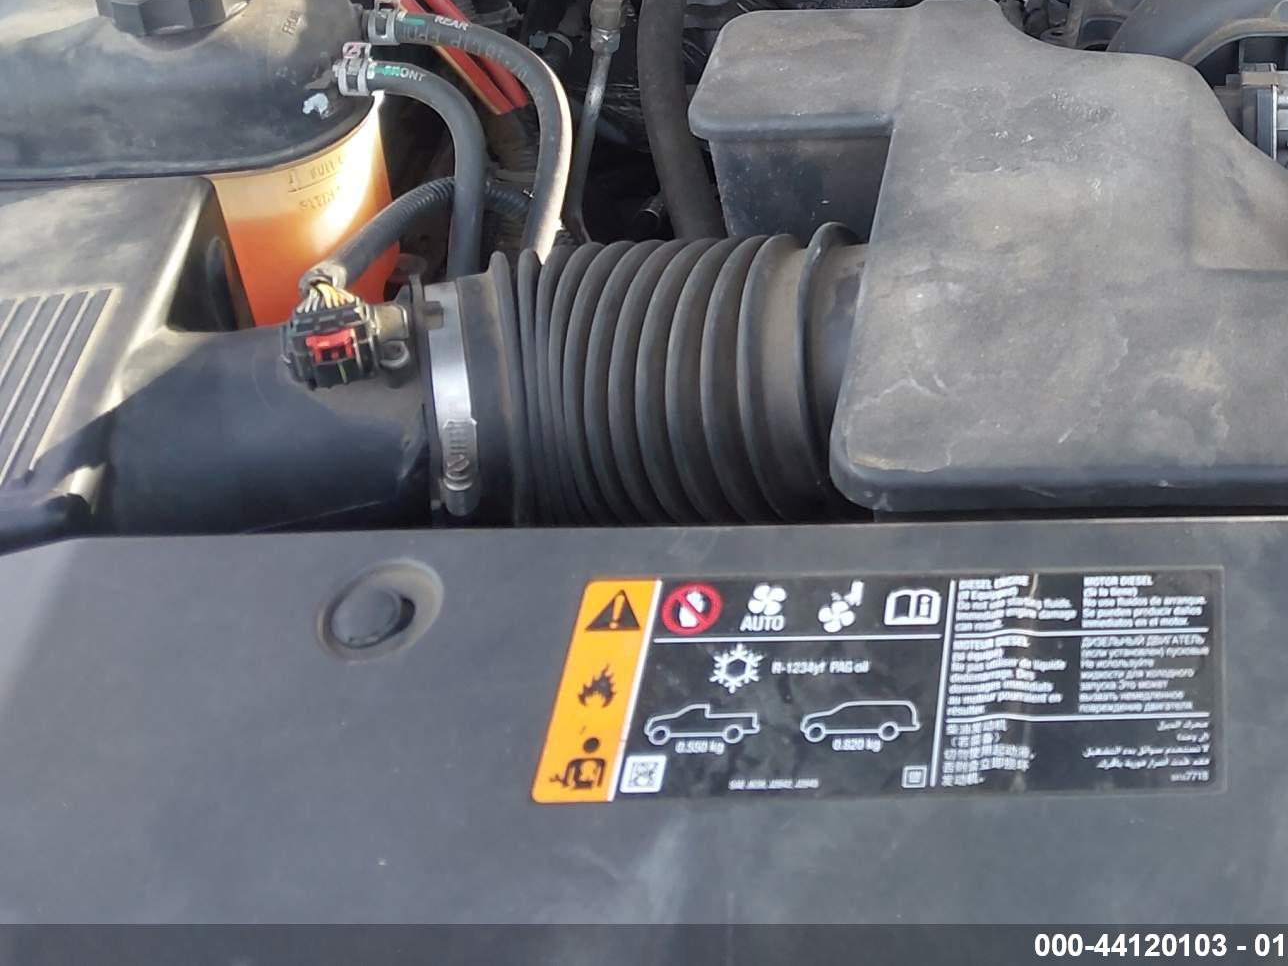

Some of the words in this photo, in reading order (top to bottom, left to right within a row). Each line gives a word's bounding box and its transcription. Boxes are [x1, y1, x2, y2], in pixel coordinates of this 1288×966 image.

[434, 15, 468, 31] REAR
[383, 65, 425, 81] FRONT
[740, 615, 784, 632] AUTO
[772, 660, 825, 675] R-1234yf
[709, 740, 725, 754] kg
[866, 738, 882, 752] kg
